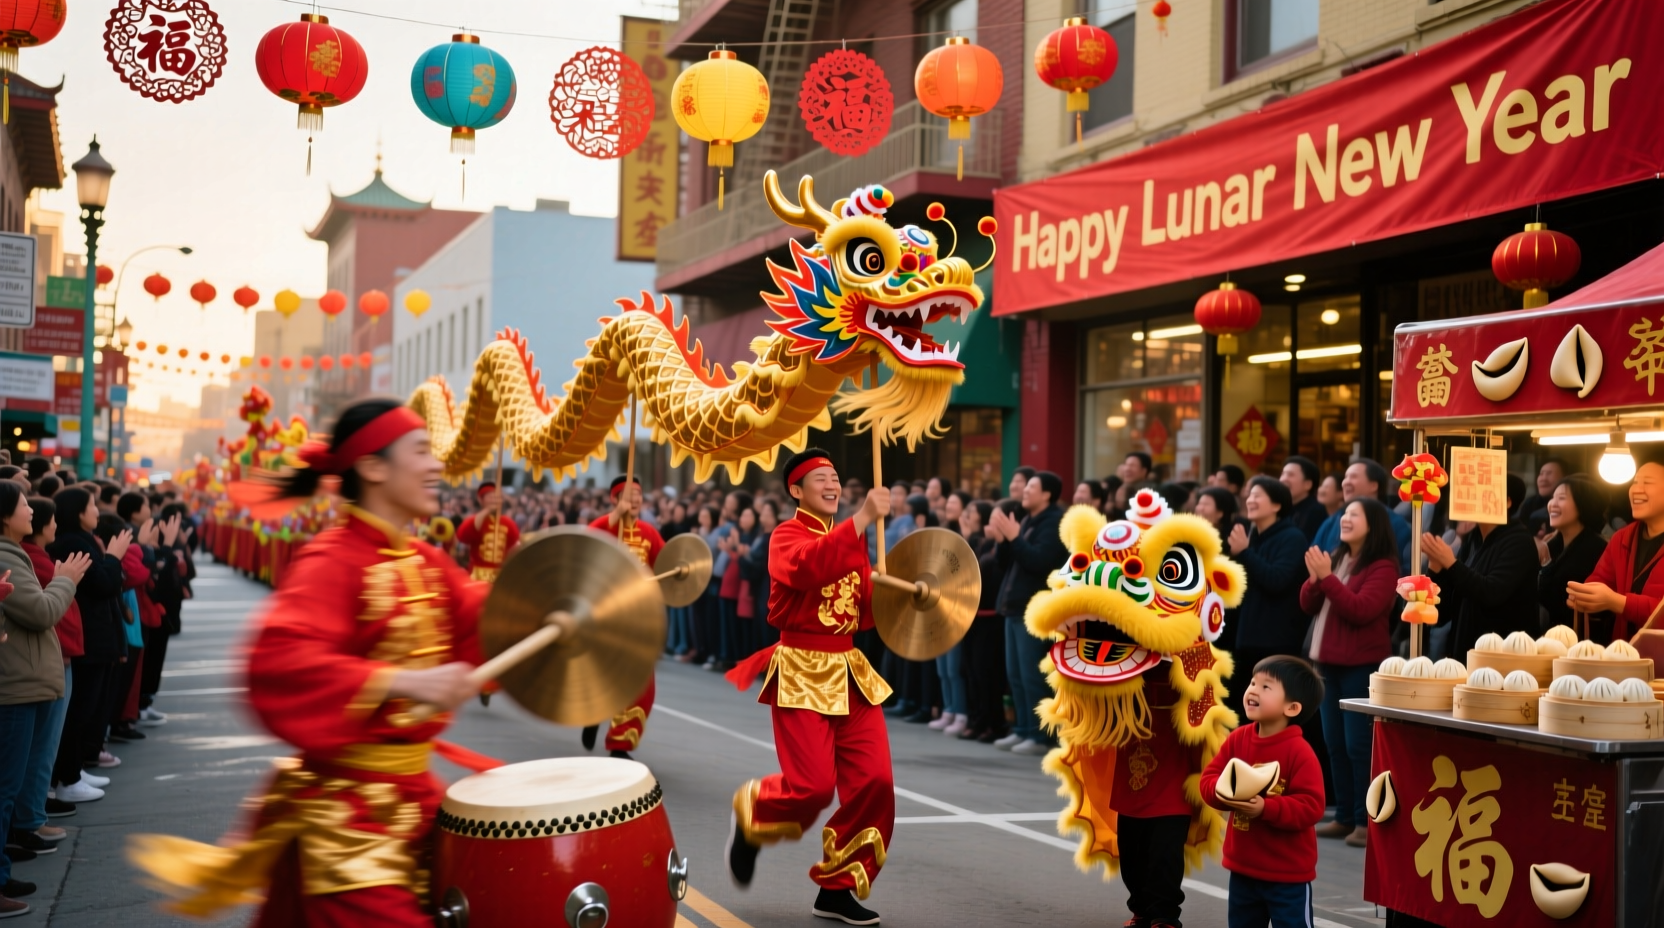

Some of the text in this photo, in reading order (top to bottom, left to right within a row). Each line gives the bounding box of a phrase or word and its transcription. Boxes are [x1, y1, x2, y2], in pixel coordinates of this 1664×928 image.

[137, 14, 197, 76] 福
[1012, 58, 1632, 283] Happy Lunar New Year
[1236, 420, 1267, 455] 福
[1411, 755, 1515, 919] 福
